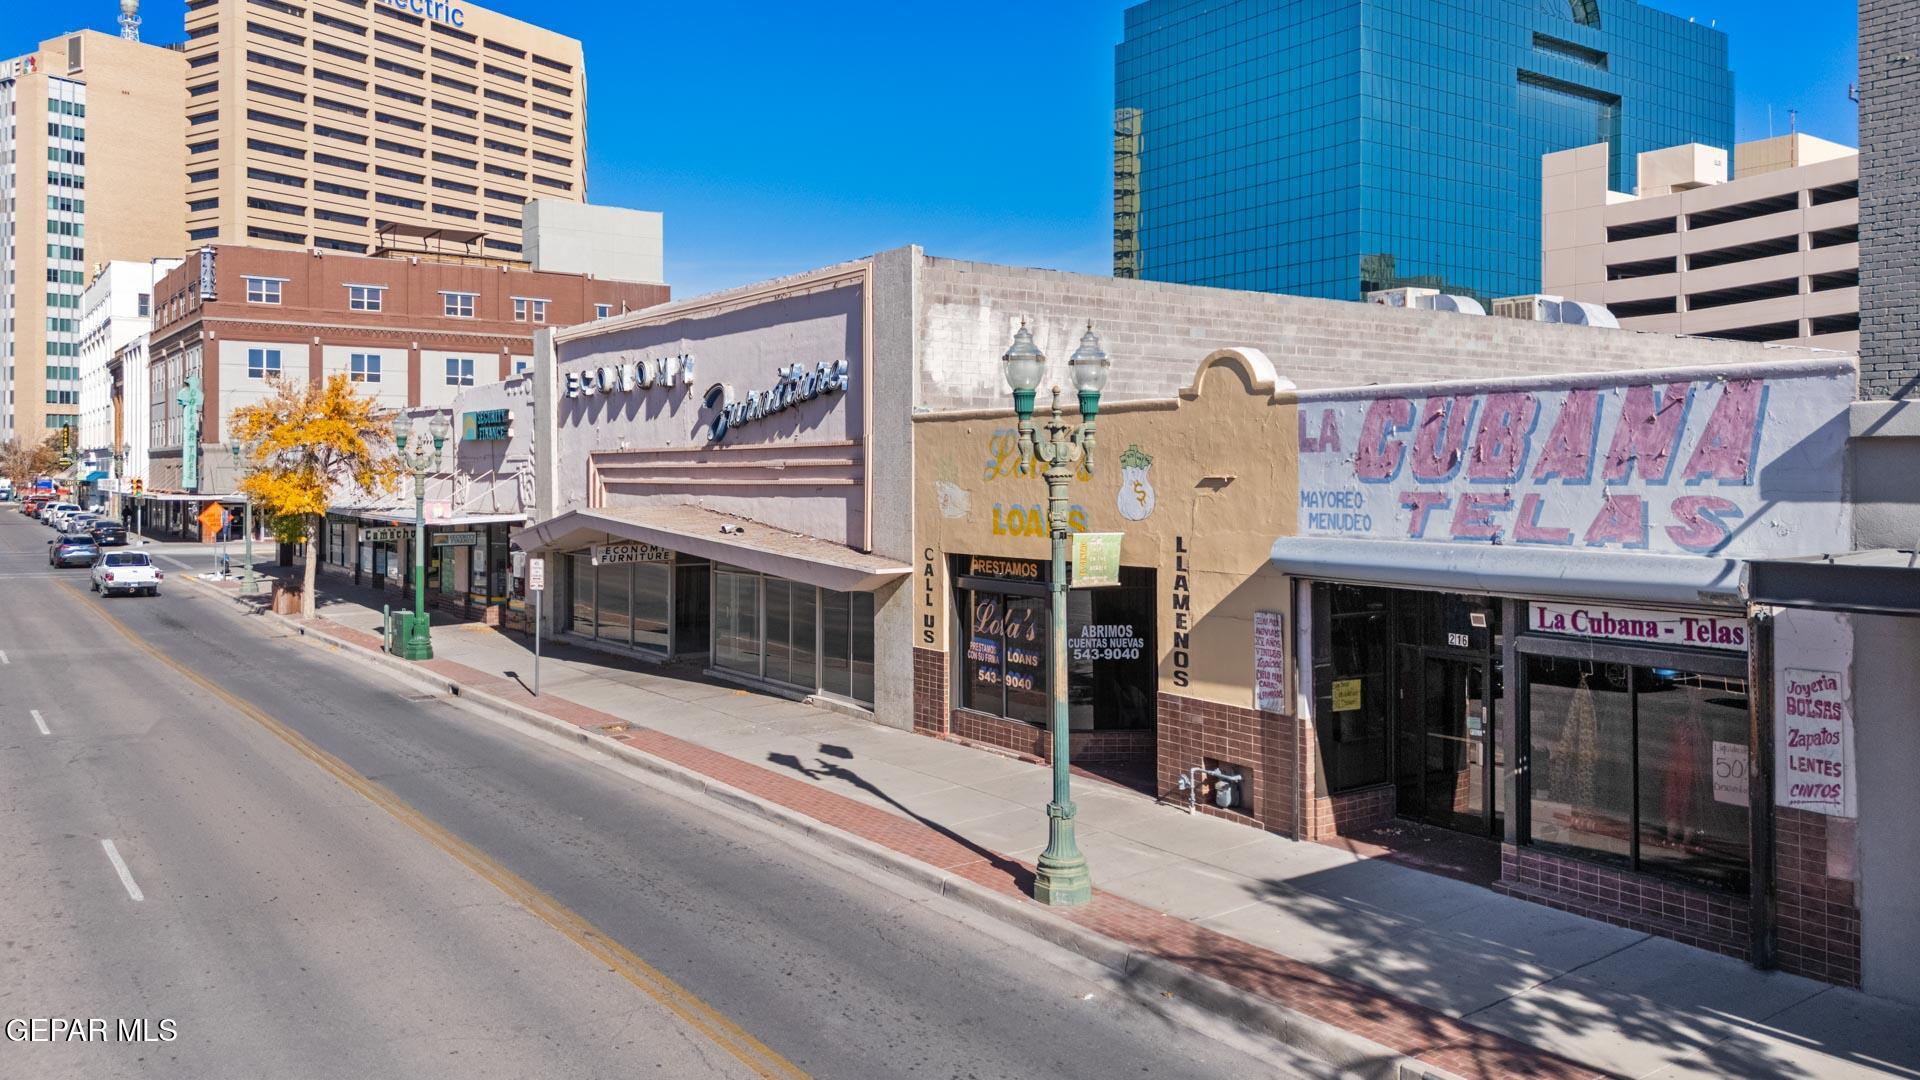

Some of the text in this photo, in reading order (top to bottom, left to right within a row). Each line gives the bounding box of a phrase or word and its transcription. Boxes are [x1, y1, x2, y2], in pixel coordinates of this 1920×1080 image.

[565, 354, 694, 398] ECONOMY
[703, 360, 848, 441] Furniture
[1298, 409, 1341, 453] LA
[1354, 378, 1770, 487] CUBANA
[1300, 490, 1364, 511] MAYOREO
[992, 503, 1088, 537] LOAS
[1308, 512, 1372, 532] MENUDEO
[1399, 490, 1744, 554] TELAS
[601, 551, 670, 563] FURNITURE
[971, 559, 1038, 577] PRESTAMOS
[923, 548, 935, 644] CALL US
[975, 602, 1036, 641] Lola's
[1173, 536, 1190, 688] LLAMENOS
[1081, 624, 1133, 638] ABRIMOS
[1537, 606, 1566, 631] La
[1571, 609, 1659, 639] Cubana
[1680, 617, 1744, 645] Telas
[1068, 638, 1144, 648] CUENTAS NUEVAS
[1449, 634, 1468, 646] 216
[1007, 650, 1038, 667] LOANS
[1073, 648, 1140, 660] 543-9040
[1787, 675, 1837, 698] Joyeria
[1786, 696, 1841, 721] BOLSAS
[1788, 727, 1840, 751] Zapatos
[1789, 755, 1842, 778] LENTES
[1790, 783, 1841, 799] CINTOS
